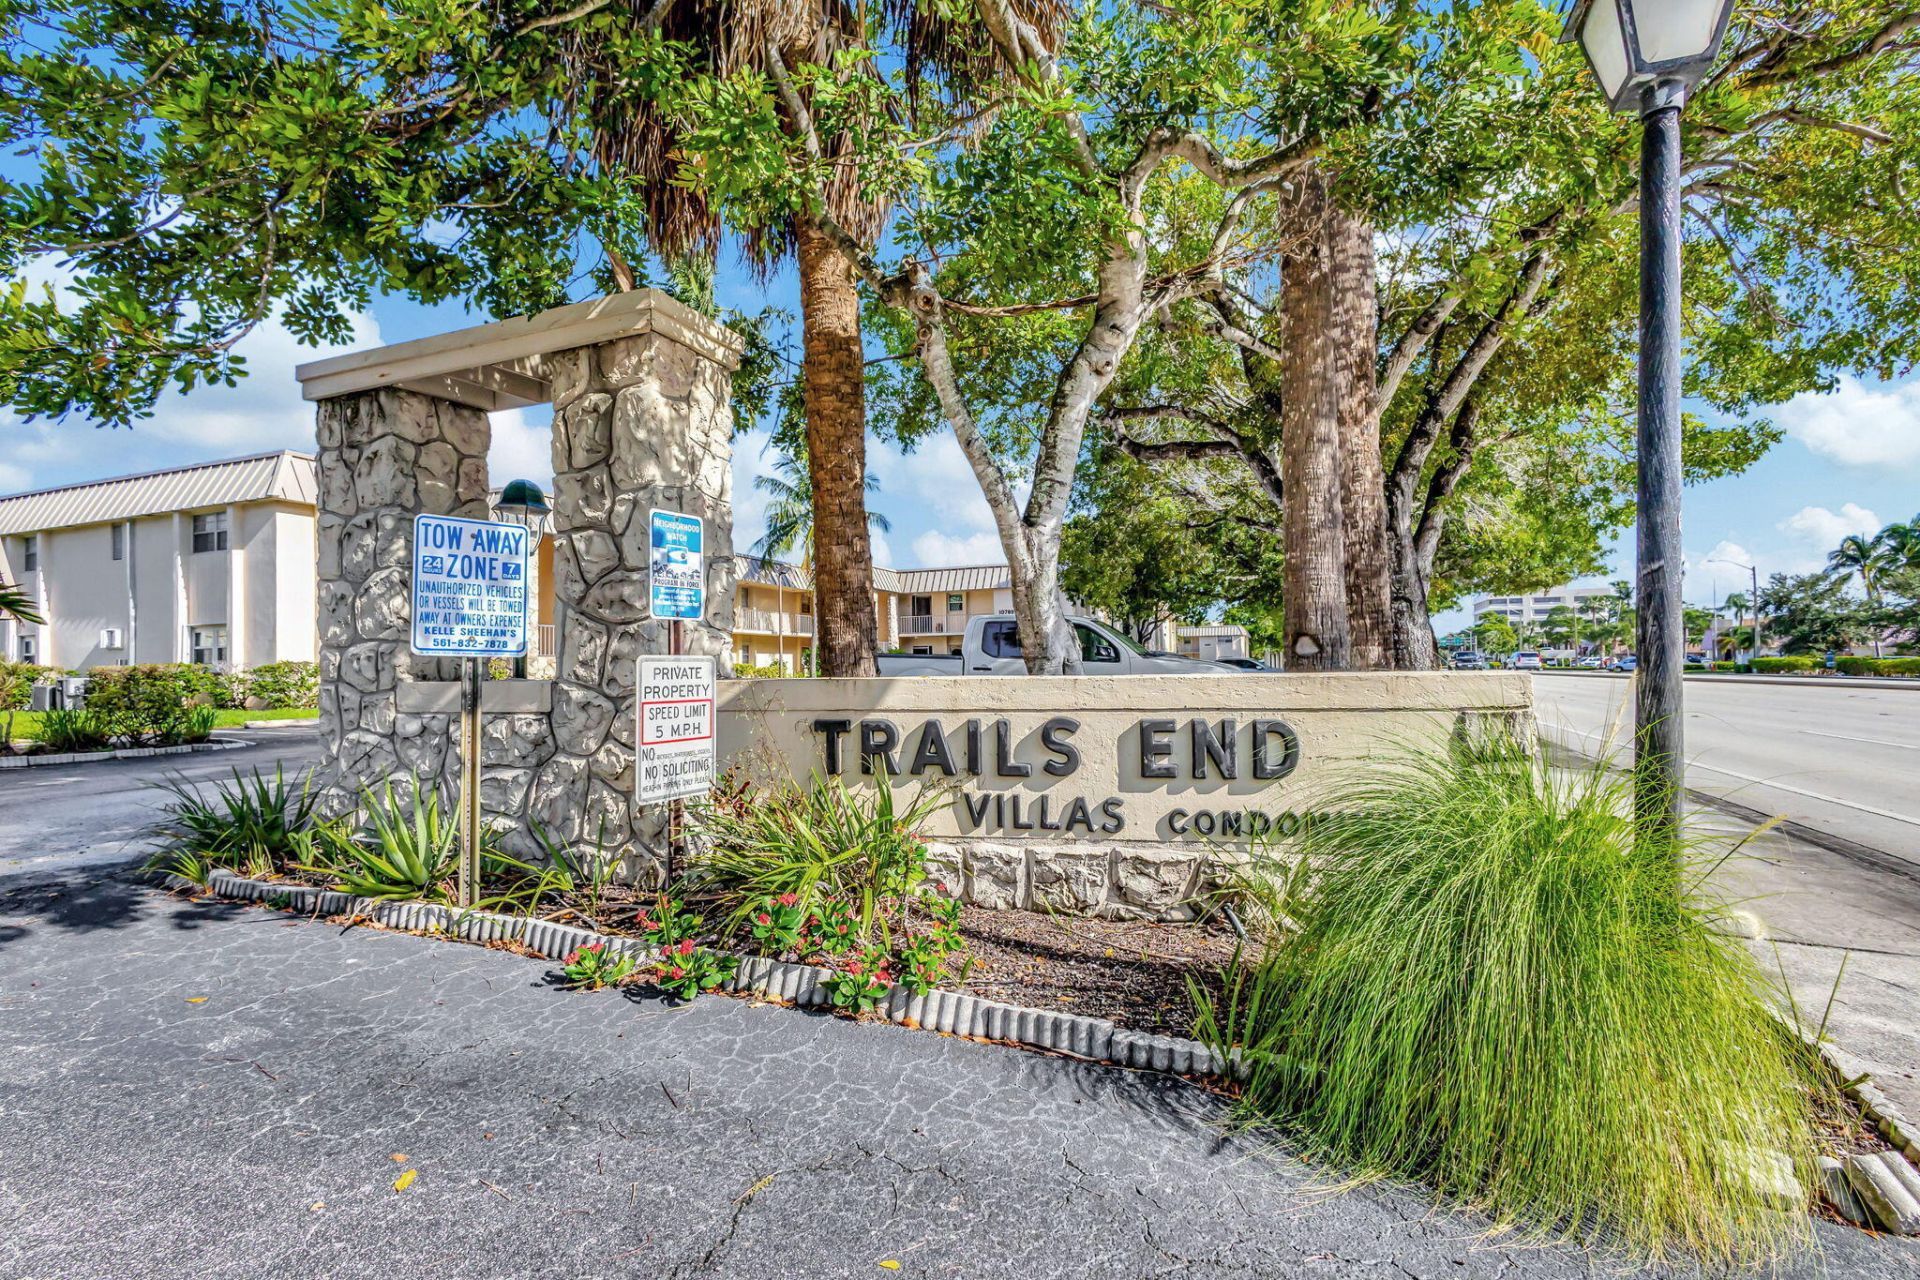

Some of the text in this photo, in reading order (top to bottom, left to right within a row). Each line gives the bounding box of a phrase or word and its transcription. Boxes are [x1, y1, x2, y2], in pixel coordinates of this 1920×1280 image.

[421, 523, 523, 555] TOW AWAY
[424, 556, 443, 568] 24
[446, 553, 499, 581] ZONE
[507, 564, 515, 575] 7
[419, 580, 523, 599] UNAUTHORIZED VEHICLES
[419, 595, 523, 613] OR VESSELS WILL BE TOWED
[418, 611, 522, 628] AWAY AT OWNERS EXPENSE
[424, 626, 517, 638] KELLE SHEEHAN'S
[653, 666, 702, 681] PRIVATE
[644, 684, 710, 700] PROPERTY
[649, 704, 707, 721] SPEED LIMIT
[655, 725, 664, 739] 5
[642, 747, 656, 762] NO
[815, 717, 1301, 779] TRAILS END
[645, 758, 710, 781] NO SOLICITING
[963, 792, 1124, 834] VILLAS
